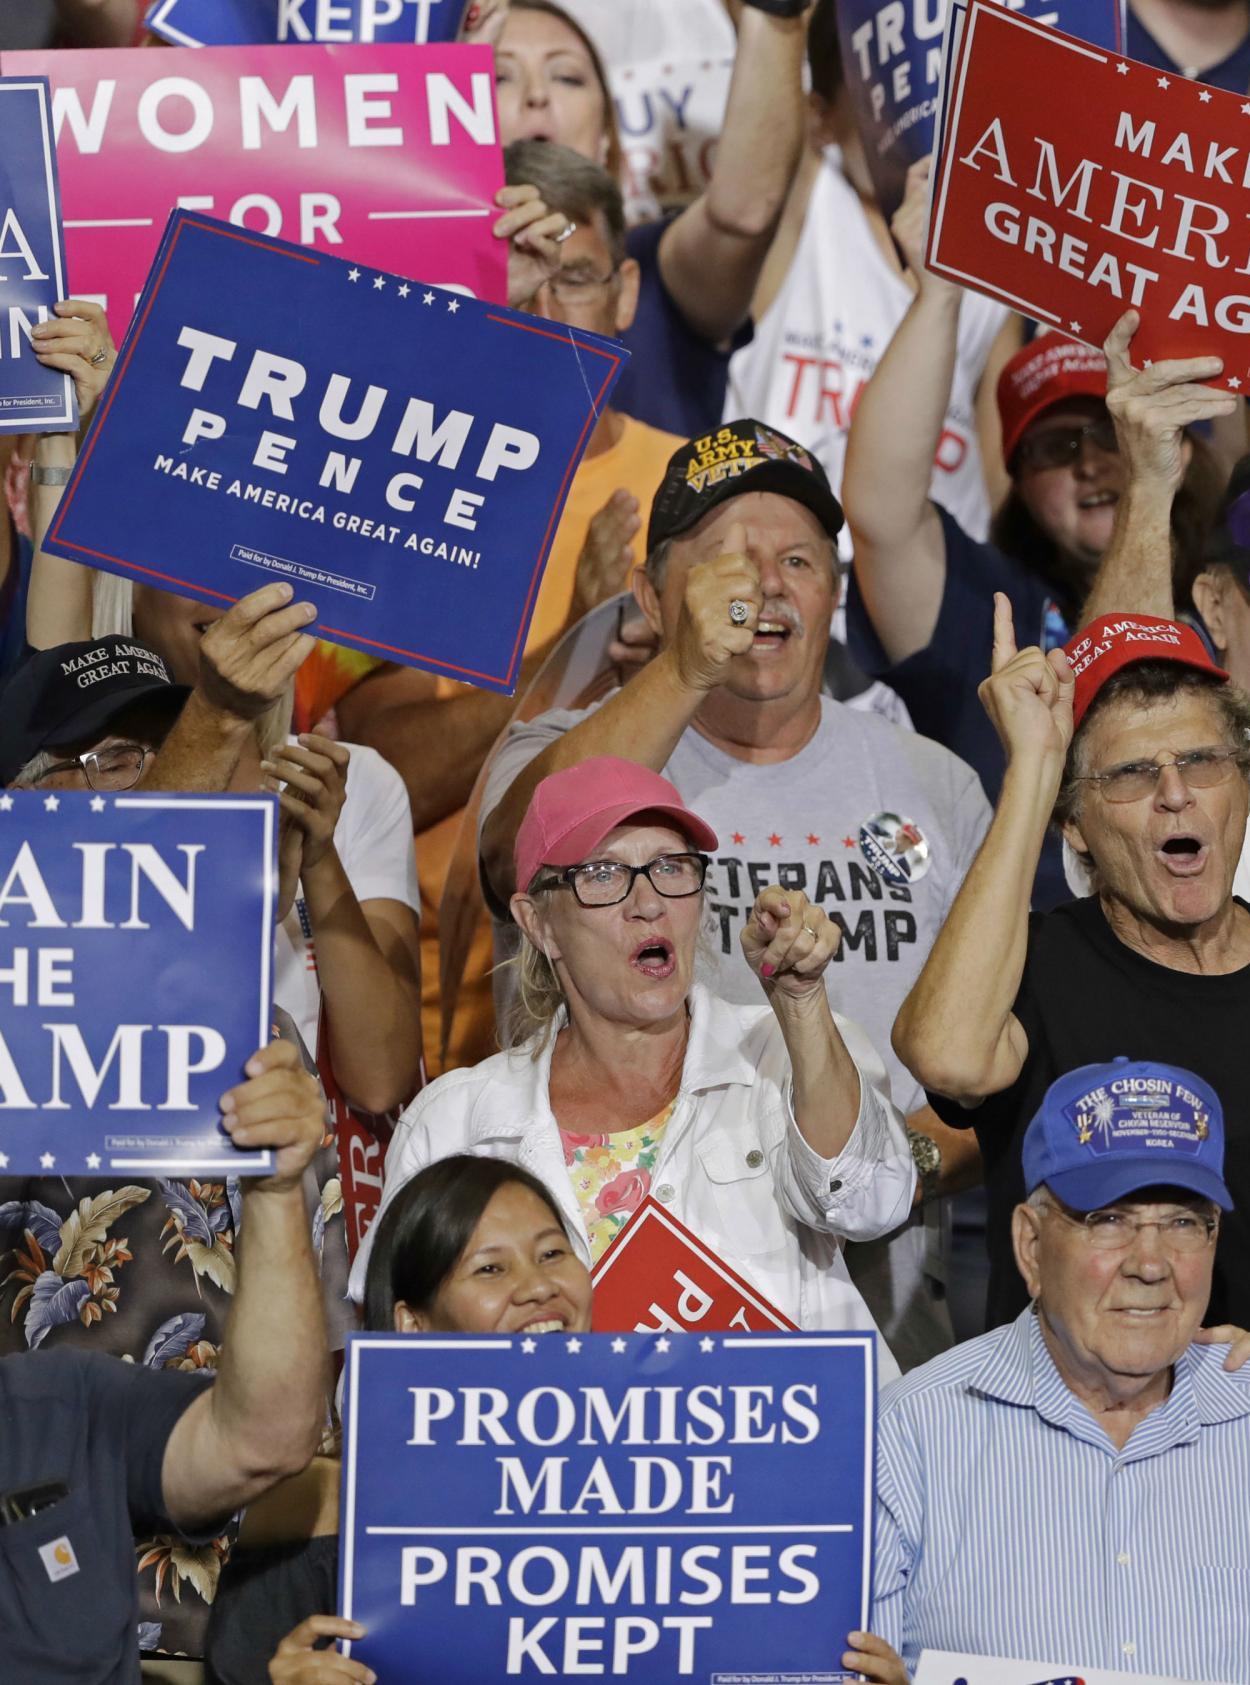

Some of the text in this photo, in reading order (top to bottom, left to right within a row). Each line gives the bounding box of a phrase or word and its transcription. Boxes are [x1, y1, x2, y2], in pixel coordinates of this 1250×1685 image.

[53, 73, 496, 154] WOMEN
[983, 202, 1159, 307] GREAT
[177, 327, 540, 481] TRUMP
[685, 439, 756, 480] ARMY
[694, 427, 739, 453] U.S.
[182, 408, 486, 531] PENCE
[154, 454, 481, 569] MAKE AMERICA GREAT AGAIN!
[238, 549, 253, 560] Paid
[253, 554, 263, 562] for
[263, 557, 271, 566] by
[272, 559, 292, 571] Donald
[298, 567, 317, 579] Trump
[317, 573, 326, 582] for
[327, 576, 356, 593] President,
[357, 585, 368, 595] Inc.
[1102, 620, 1182, 638] AMERICA
[1125, 631, 1181, 645] AGAIN
[61, 648, 110, 675] MAKE
[77, 661, 130, 688] GREAT
[710, 902, 917, 964] TMP
[1076, 1078, 1204, 1111] THE CHOSIN FEW
[1131, 1111, 1181, 1120] VETERAN OF
[1118, 1120, 1149, 1129] CHOSIN
[1145, 1138, 1175, 1148] KOREA
[406, 1384, 821, 1446] PROMISES
[494, 1455, 735, 1516] MADE
[401, 1544, 820, 1606] PROMISES
[506, 1616, 713, 1675] KEPT
[717, 1675, 732, 1683] Paid
[751, 1675, 774, 1683] Donald
[780, 1675, 801, 1684] Trump
